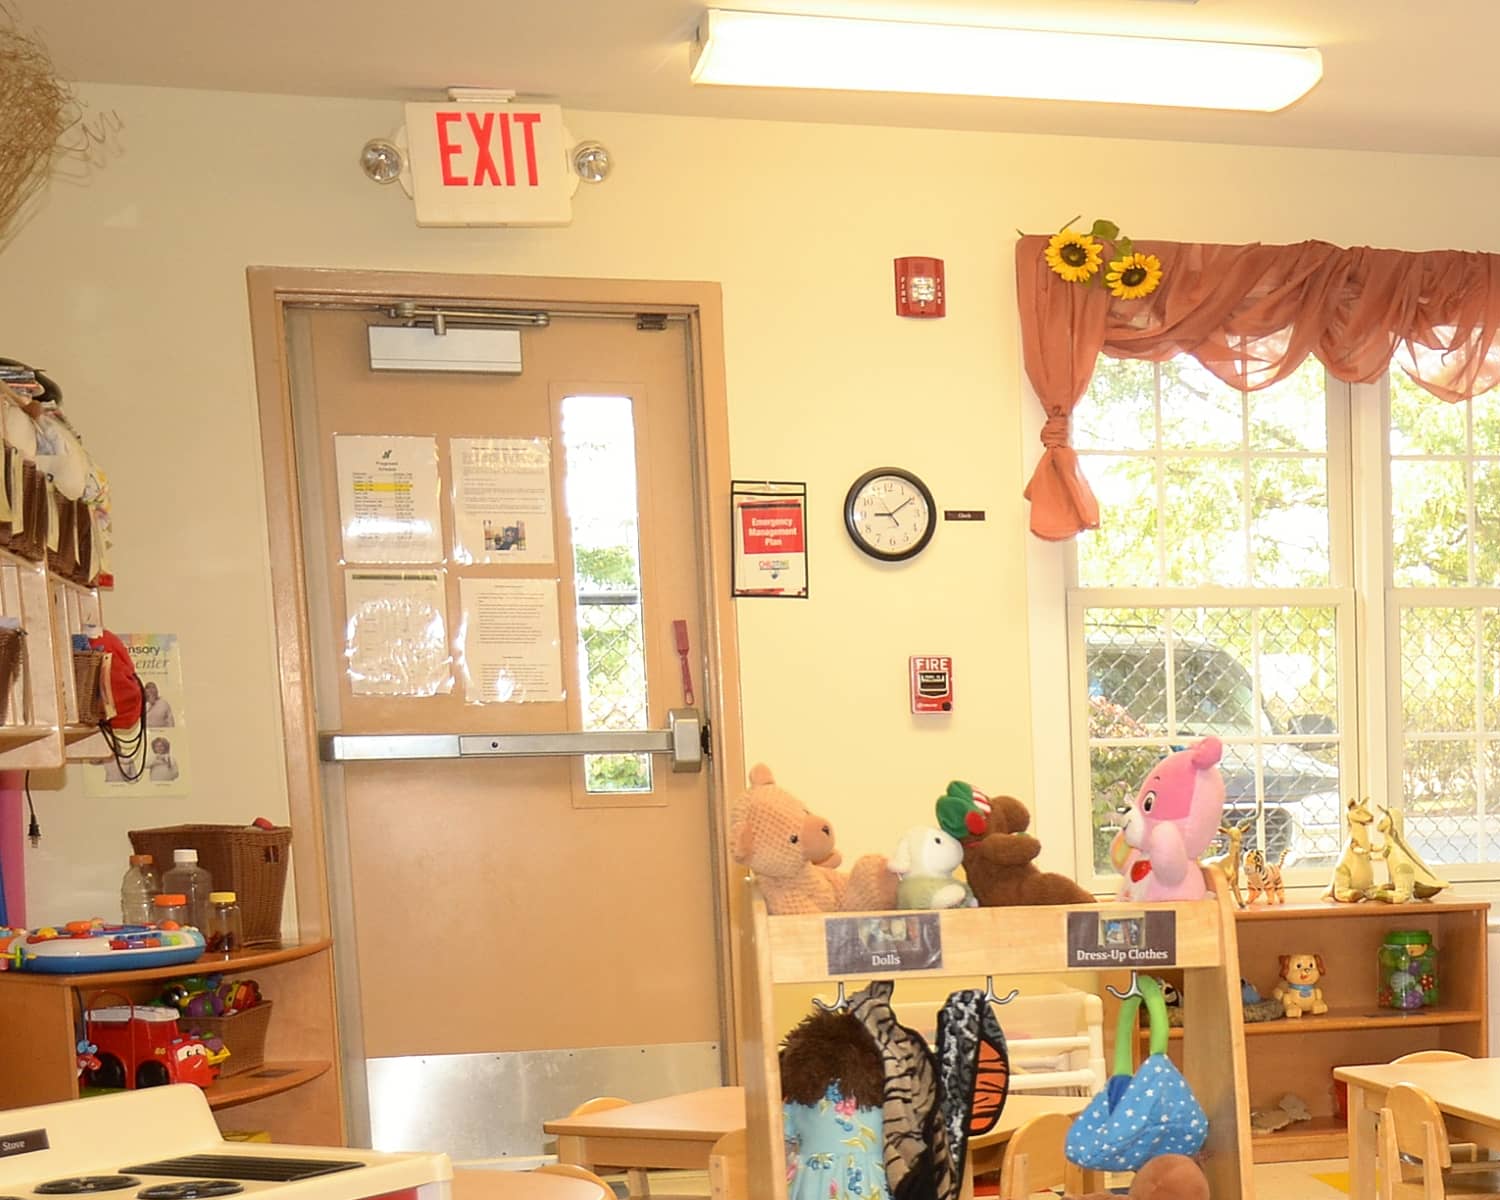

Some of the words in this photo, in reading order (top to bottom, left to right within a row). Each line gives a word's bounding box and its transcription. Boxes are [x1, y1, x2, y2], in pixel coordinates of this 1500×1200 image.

[435, 111, 541, 187] EXIT
[752, 517, 792, 527] Emergency
[748, 528, 797, 537] Management
[765, 538, 782, 546] Plan
[128, 645, 160, 656] nsory
[135, 656, 169, 669] enter
[916, 659, 949, 670] FIRE
[871, 953, 901, 967] Dolls
[1076, 948, 1127, 961] Dress-Up
[1128, 948, 1168, 960] Clothes
[2, 1140, 25, 1151] Stove
